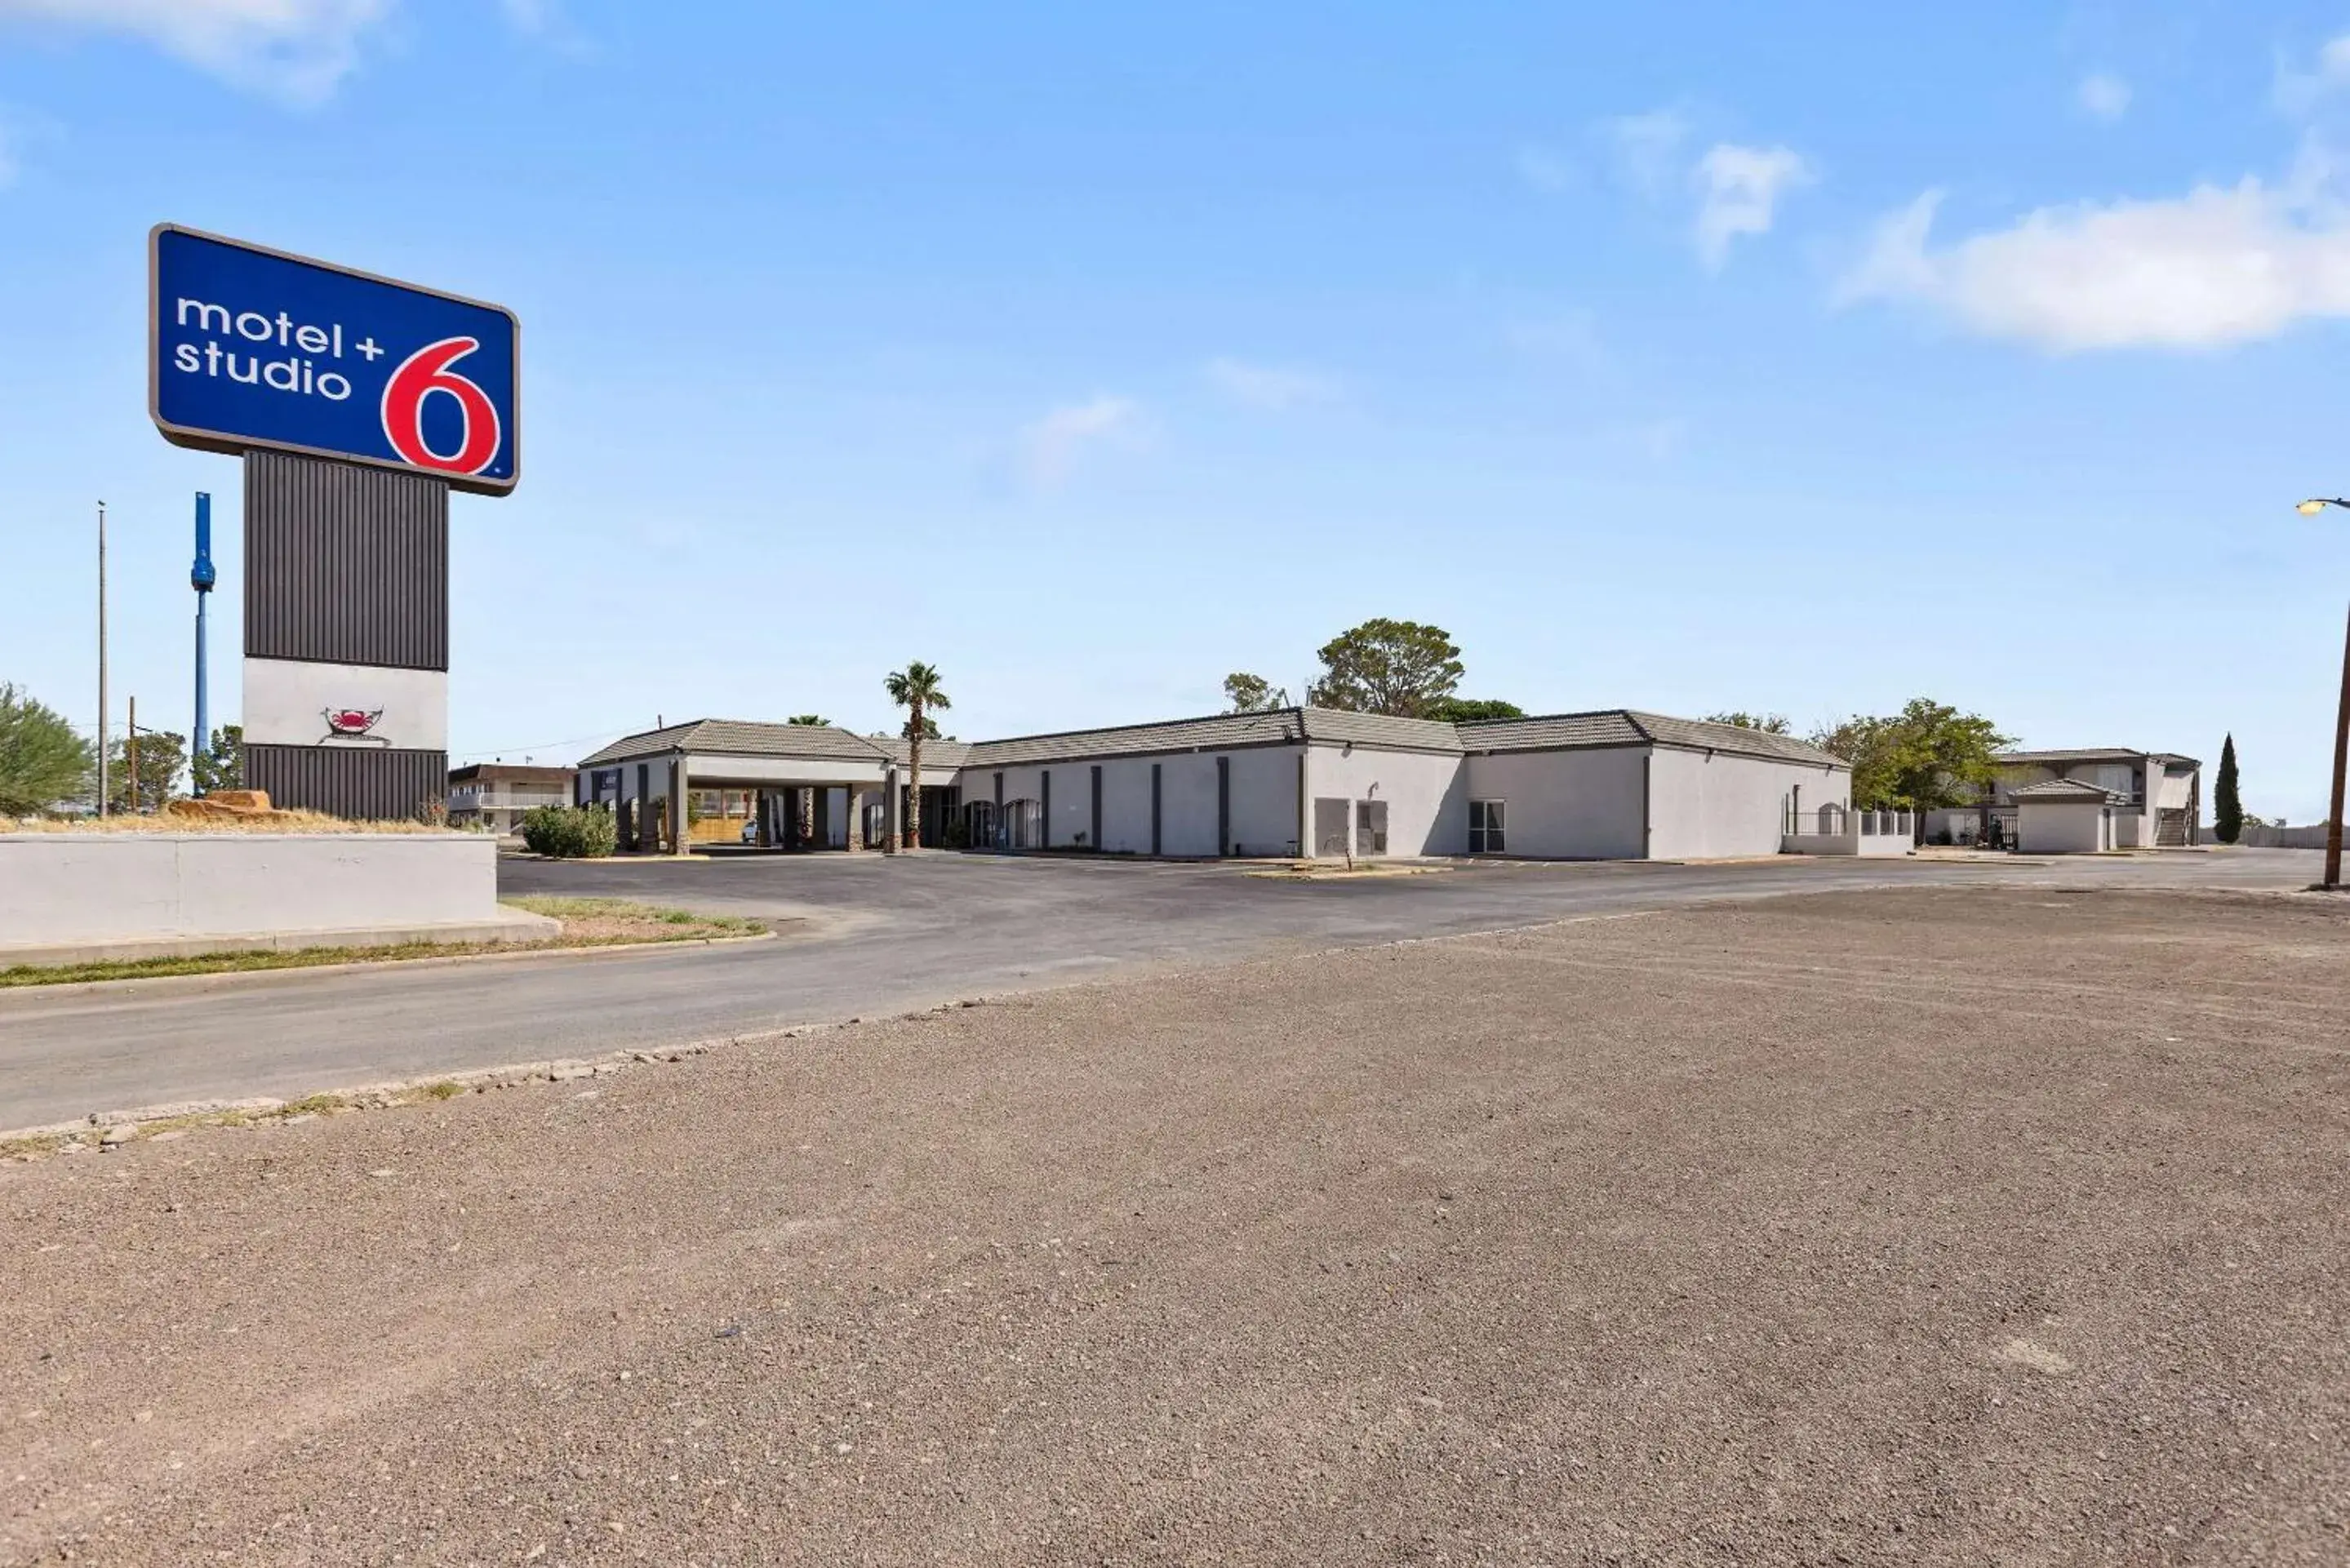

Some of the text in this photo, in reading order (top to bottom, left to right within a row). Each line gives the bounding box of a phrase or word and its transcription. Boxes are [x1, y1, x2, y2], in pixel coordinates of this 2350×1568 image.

[177, 297, 342, 358] motel
[174, 341, 352, 401] studio
[380, 335, 501, 477] 6
